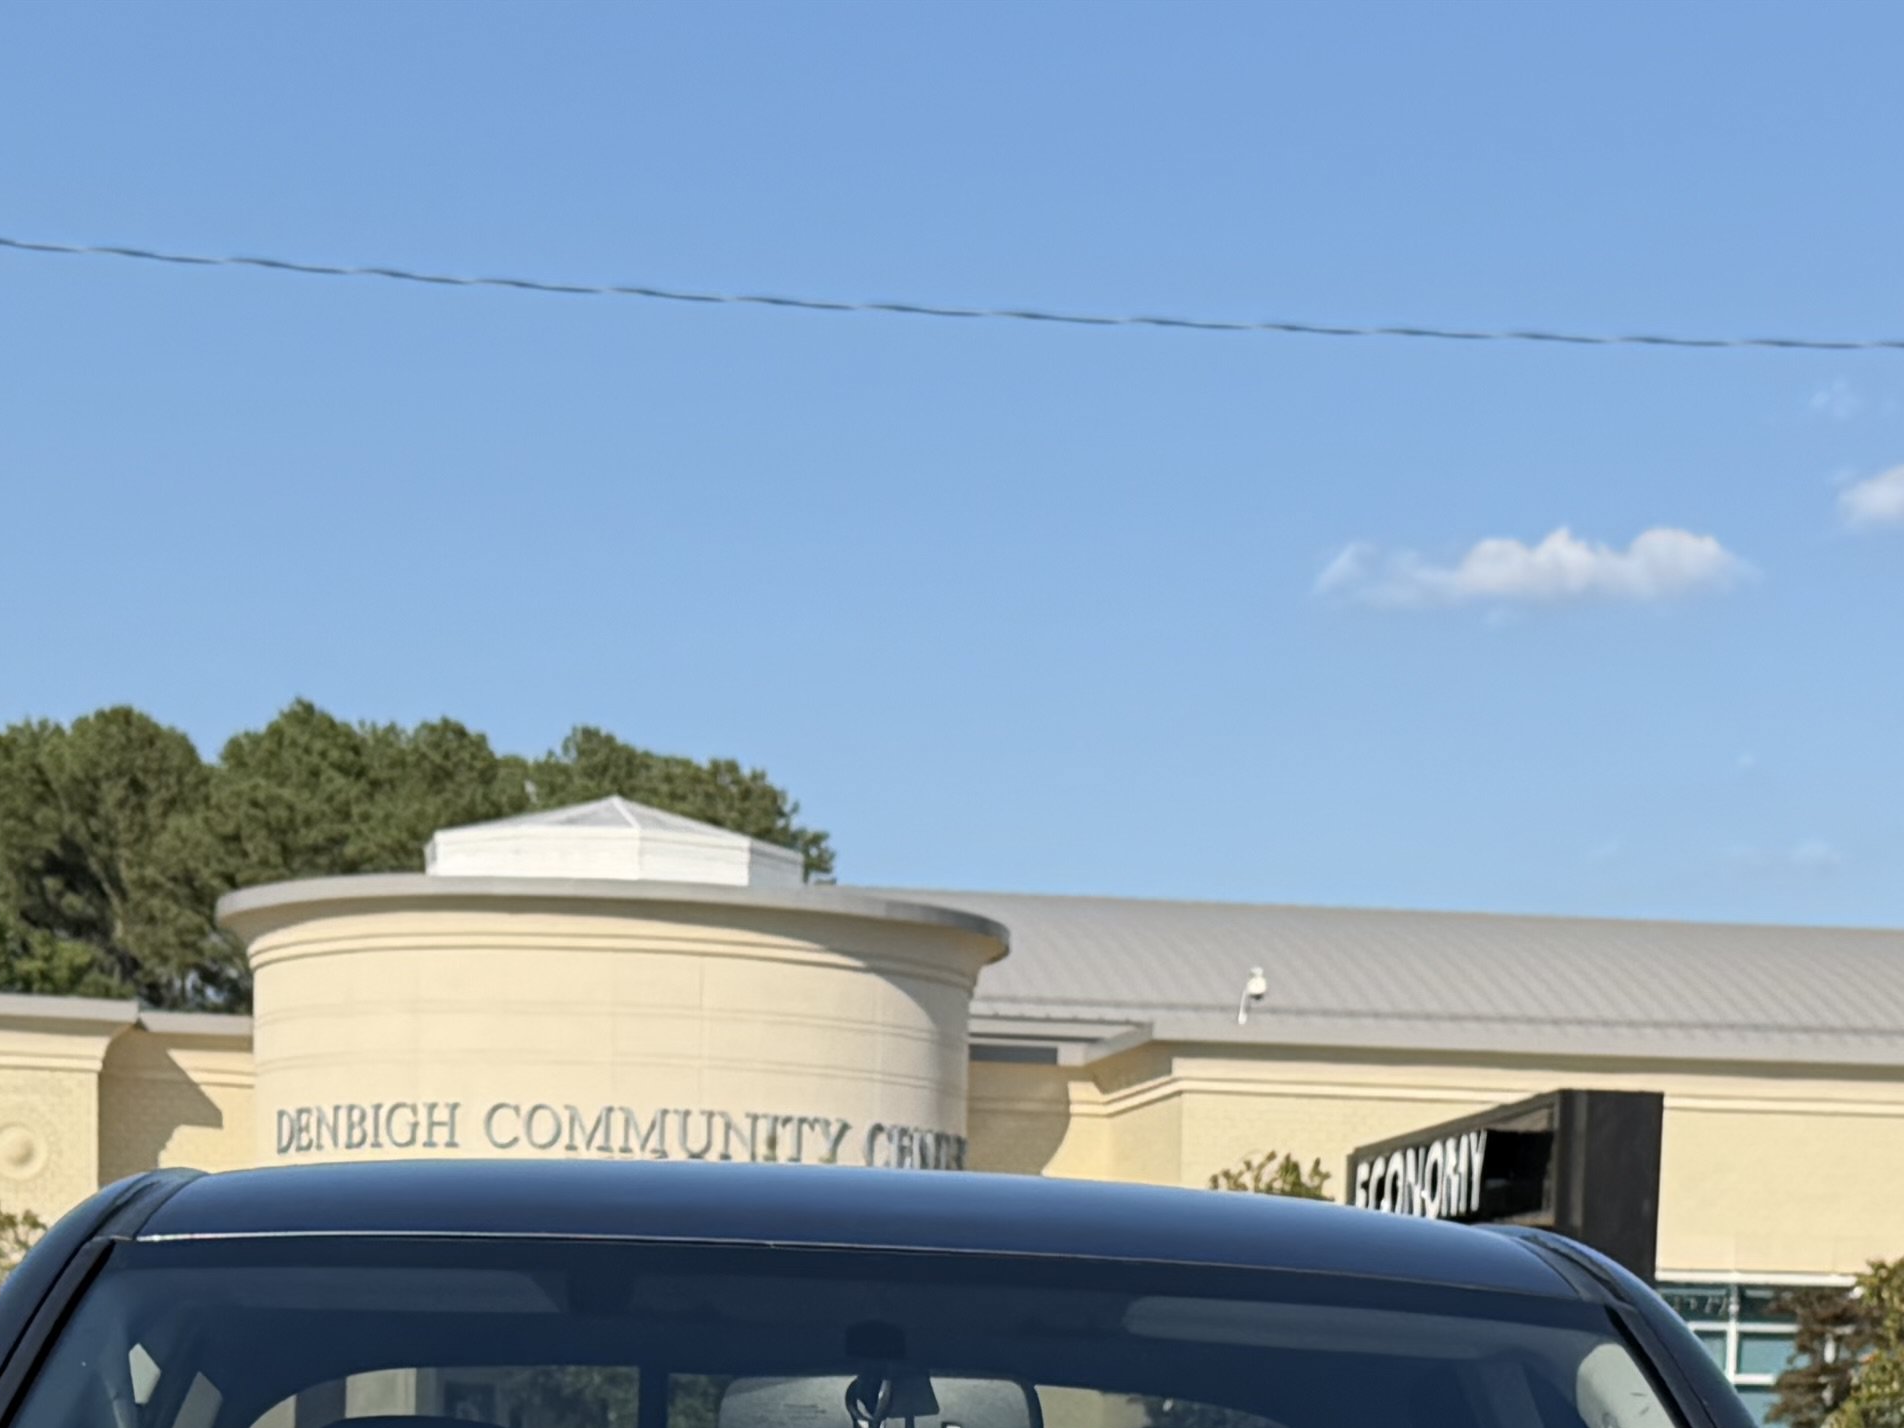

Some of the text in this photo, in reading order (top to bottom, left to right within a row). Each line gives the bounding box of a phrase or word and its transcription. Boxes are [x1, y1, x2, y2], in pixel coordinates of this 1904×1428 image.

[276, 1101, 461, 1155] DENBIGH
[484, 1102, 853, 1164] COMMUNITY
[1355, 1128, 1487, 1219] ECONOMY
